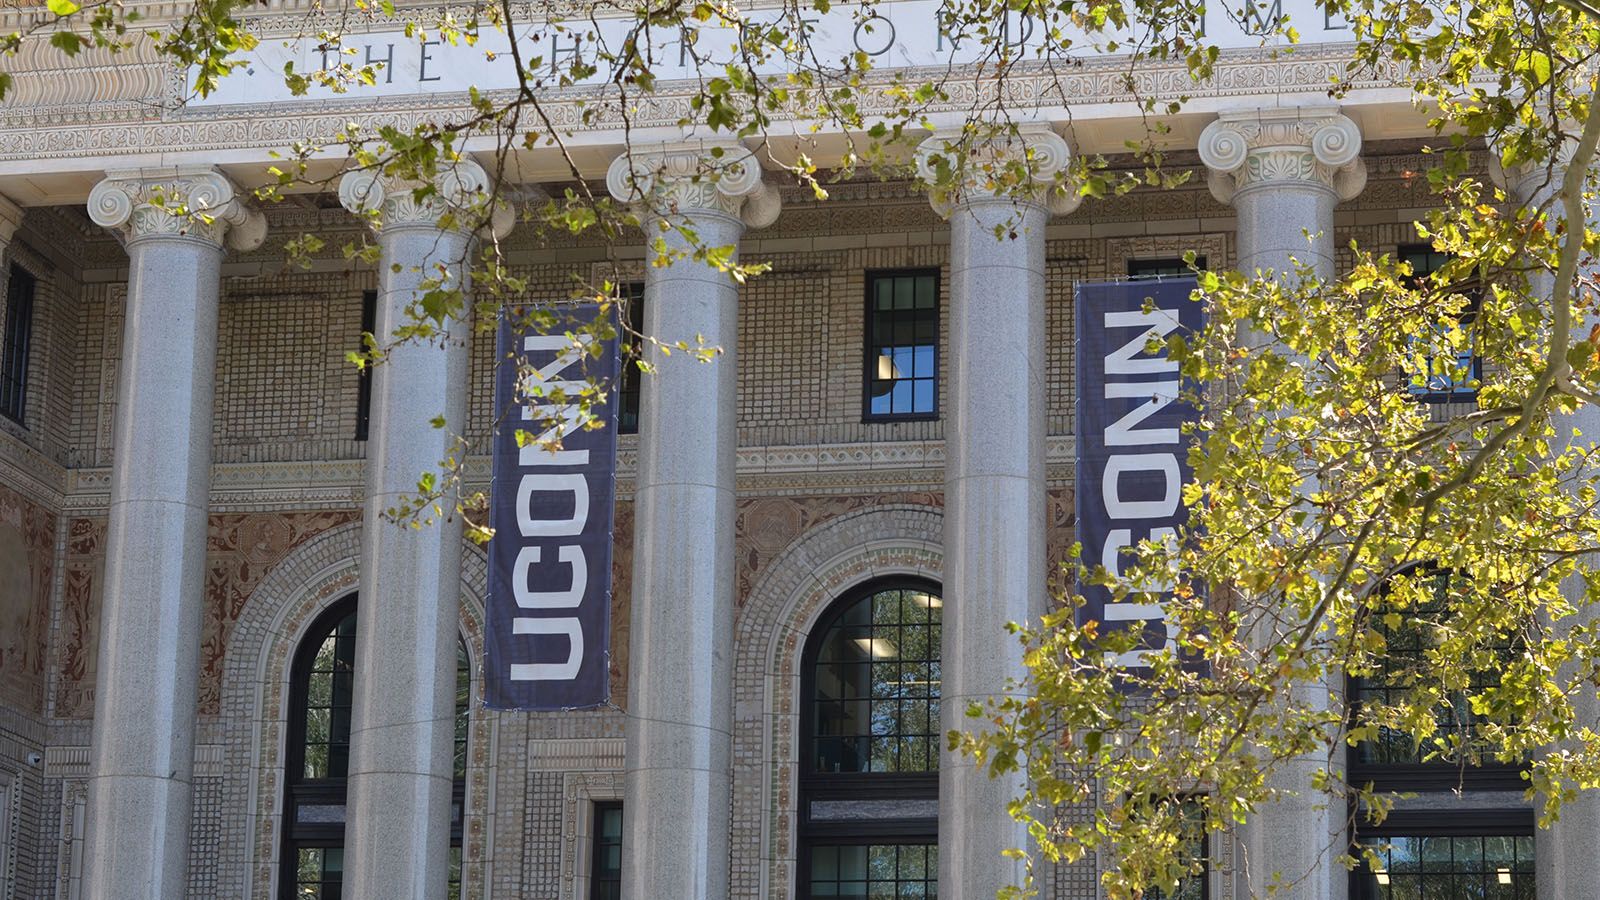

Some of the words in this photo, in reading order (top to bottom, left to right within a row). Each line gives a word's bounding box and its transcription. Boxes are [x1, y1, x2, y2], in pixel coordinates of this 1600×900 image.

[311, 41, 441, 87] THE
[510, 333, 592, 681] UCONN
[1102, 309, 1182, 668] UCONN
